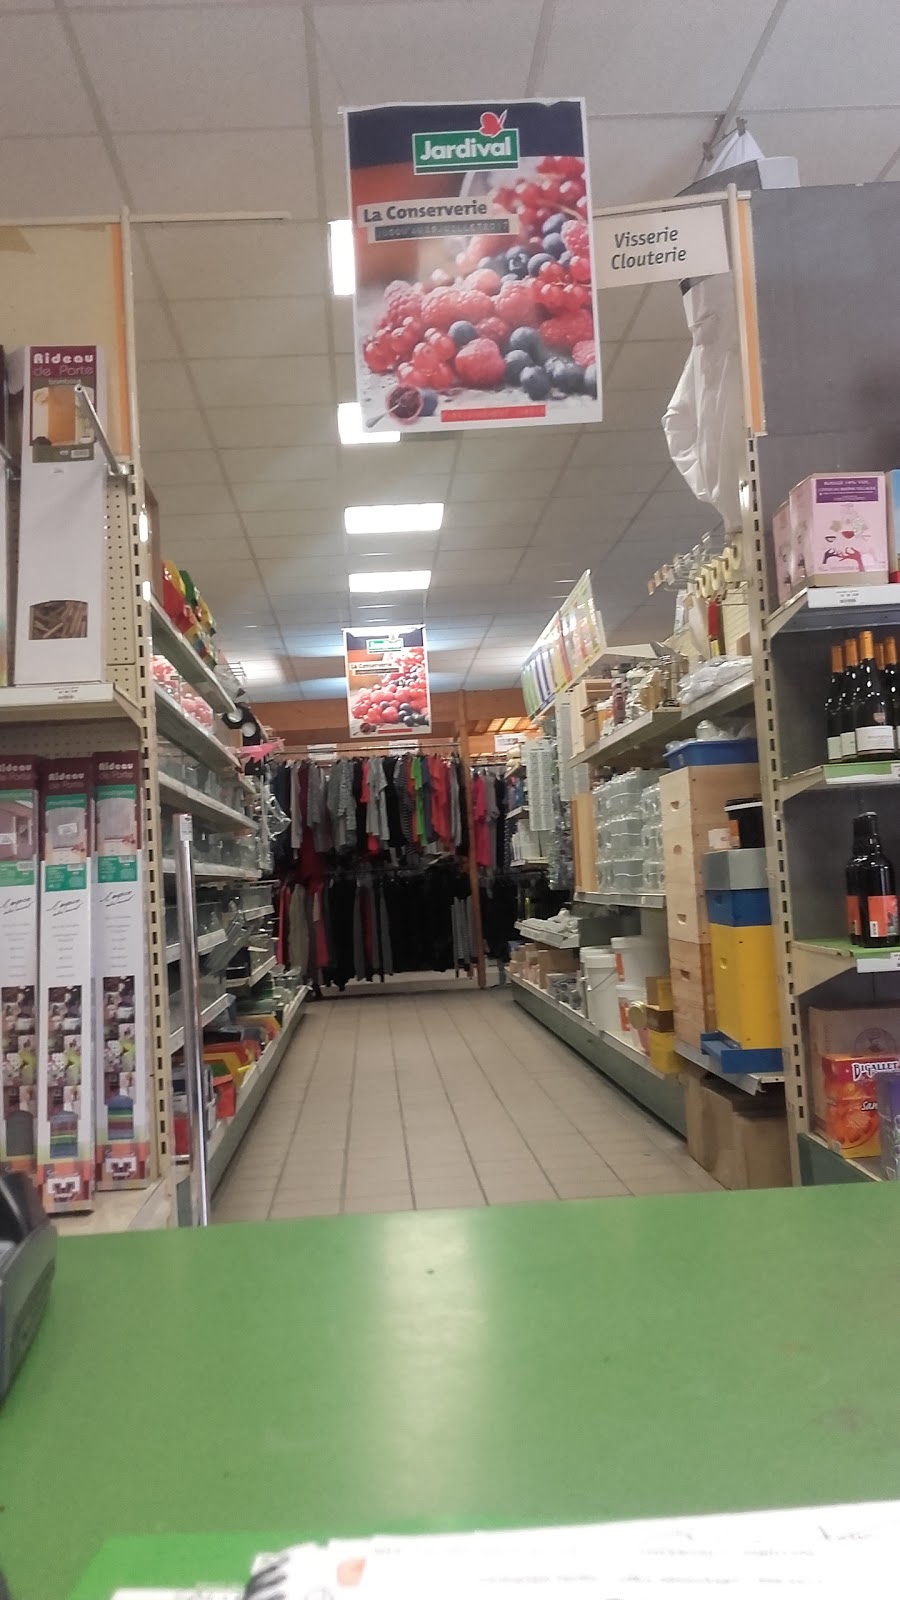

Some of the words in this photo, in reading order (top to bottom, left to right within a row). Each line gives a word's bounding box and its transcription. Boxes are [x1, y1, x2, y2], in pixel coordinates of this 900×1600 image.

[420, 136, 512, 160] Jardival
[363, 208, 382, 222] La
[386, 200, 488, 219] Conserverie
[614, 226, 679, 249] Visserie
[611, 246, 687, 270] Clouterie
[33, 352, 94, 364] Rideau
[33, 366, 52, 376] de
[59, 364, 94, 376] Porte
[852, 1062, 899, 1081] BIGALLET
